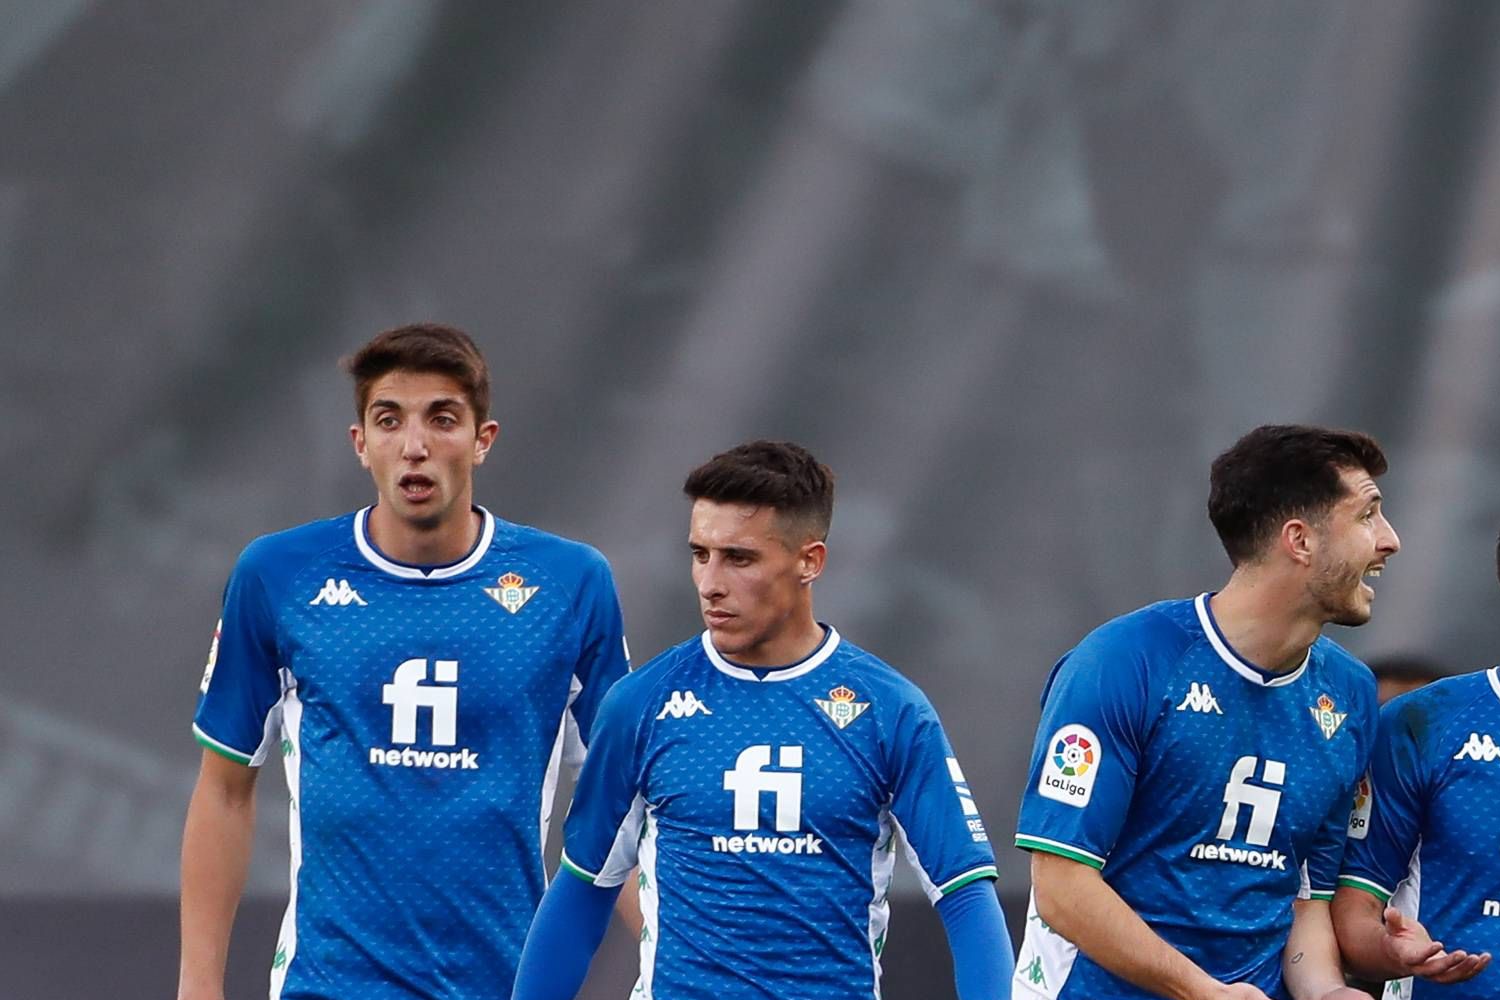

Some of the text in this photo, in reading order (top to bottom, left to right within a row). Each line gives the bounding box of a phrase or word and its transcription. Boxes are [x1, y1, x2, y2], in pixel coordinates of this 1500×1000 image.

[369, 745, 479, 770] network
[1044, 773, 1087, 797] LaLiga
[711, 833, 823, 855] network
[1190, 843, 1286, 871] network
